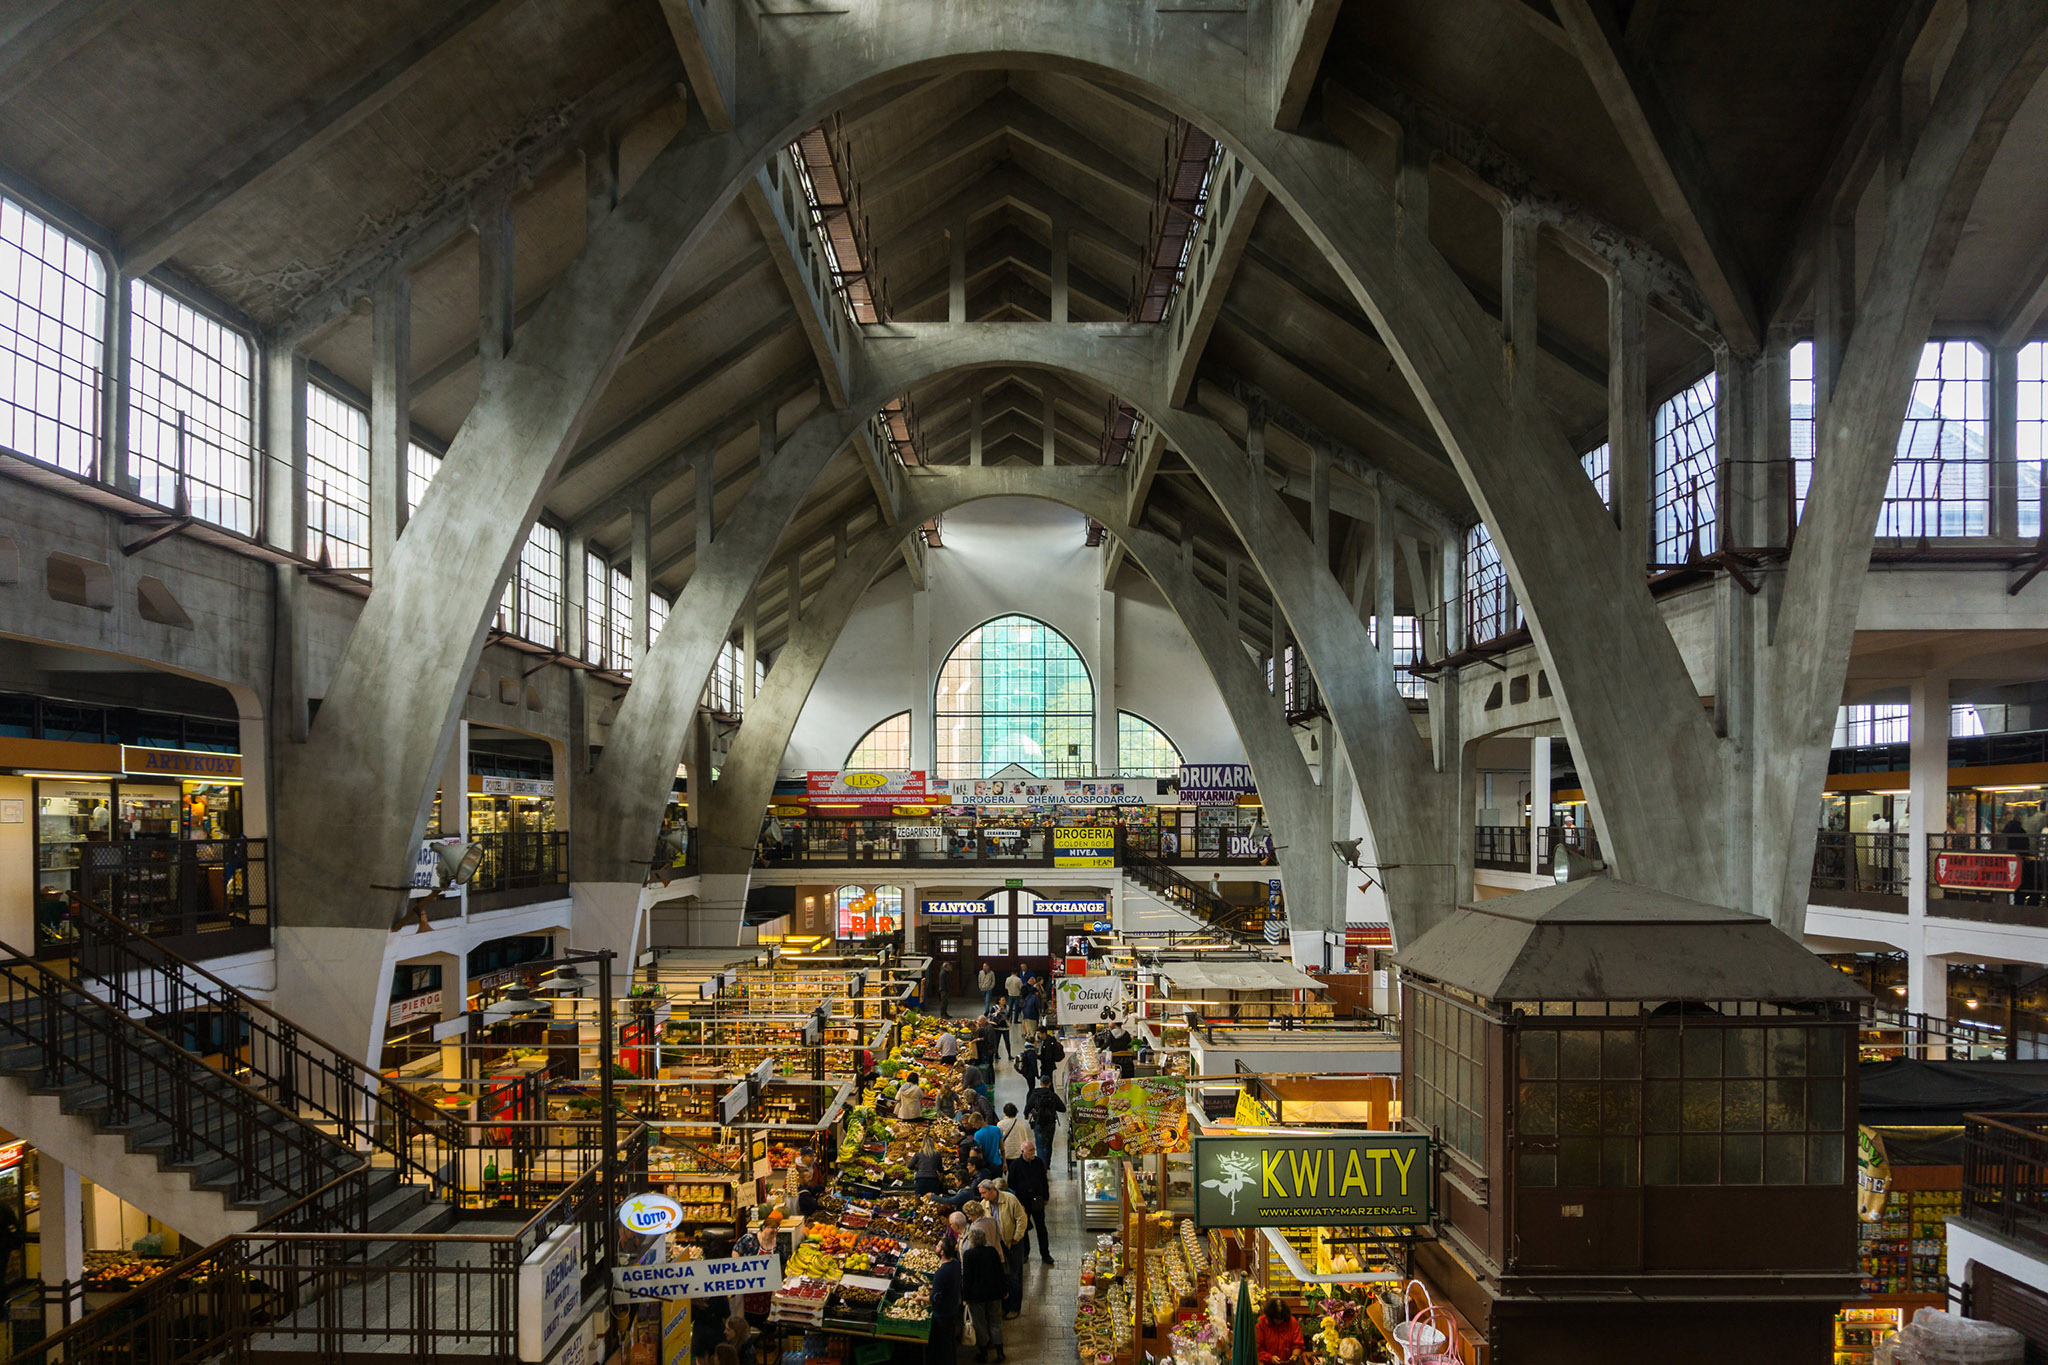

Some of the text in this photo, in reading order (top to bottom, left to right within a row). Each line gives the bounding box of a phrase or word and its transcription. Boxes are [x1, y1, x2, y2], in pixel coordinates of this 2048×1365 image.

[146, 753, 235, 773] ARTYKUŁY
[1180, 766, 1255, 788] DRUKARN
[962, 795, 1015, 804] DROGERIA
[1027, 795, 1144, 804] CHEMIA GOSPODARCZA
[1180, 790, 1235, 801] DRUKARNIA
[897, 827, 941, 838] ZEGARMISTRZ
[1055, 829, 1113, 839] DROGERIA
[1058, 840, 1110, 848] GOLDEN ROSE
[928, 902, 987, 914] KANTOR
[1035, 902, 1104, 914] EXCHANGE
[851, 916, 892, 932] BAR
[1078, 988, 1113, 1002] Oliwki
[402, 994, 440, 1013] PIEROG
[1066, 1002, 1098, 1012] Targowa
[1261, 1148, 1417, 1198] KWIATY
[637, 1210, 667, 1226] LOTTO
[1258, 1206, 1417, 1218] WWW.KWIATY-MARZENA.PL
[545, 1246, 578, 1300] AGENCJA
[622, 1259, 770, 1283] AGENCJA WPŁATY
[629, 1283, 690, 1299] LOKATY
[704, 1276, 766, 1293] KREDYT
